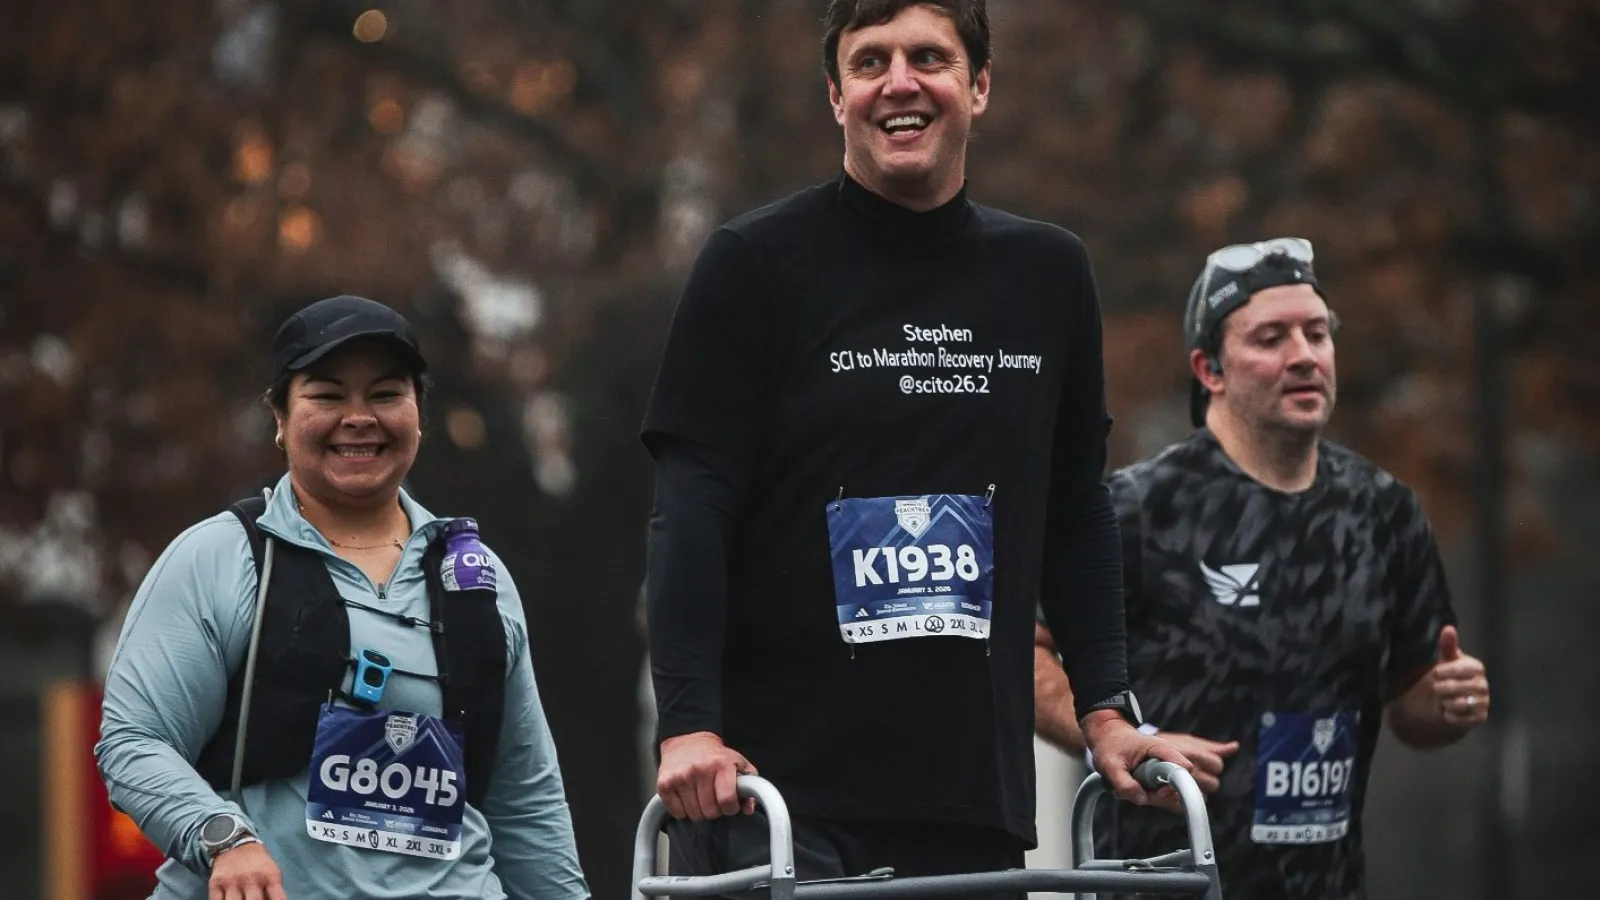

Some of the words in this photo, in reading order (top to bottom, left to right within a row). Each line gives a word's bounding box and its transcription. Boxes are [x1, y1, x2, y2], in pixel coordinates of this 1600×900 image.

[903, 324, 973, 345] Stephen
[830, 350, 855, 373] SCI
[856, 351, 873, 369] to
[873, 347, 935, 368] Marathon
[938, 347, 994, 373] Recovery
[997, 349, 1042, 375] Journey
[899, 374, 990, 395] @scito26.2
[852, 544, 980, 588] K1938
[859, 625, 874, 637] XS
[881, 623, 889, 634] S
[896, 621, 908, 633] M
[915, 620, 921, 630] L
[949, 618, 966, 630] 2XL
[319, 754, 458, 807] G8045
[1265, 756, 1355, 797] B16197
[322, 827, 335, 839] XS
[342, 830, 349, 841] S
[356, 832, 366, 843] M
[386, 836, 398, 848] XL
[405, 839, 422, 852] 2XL
[428, 843, 445, 855] 3XL
